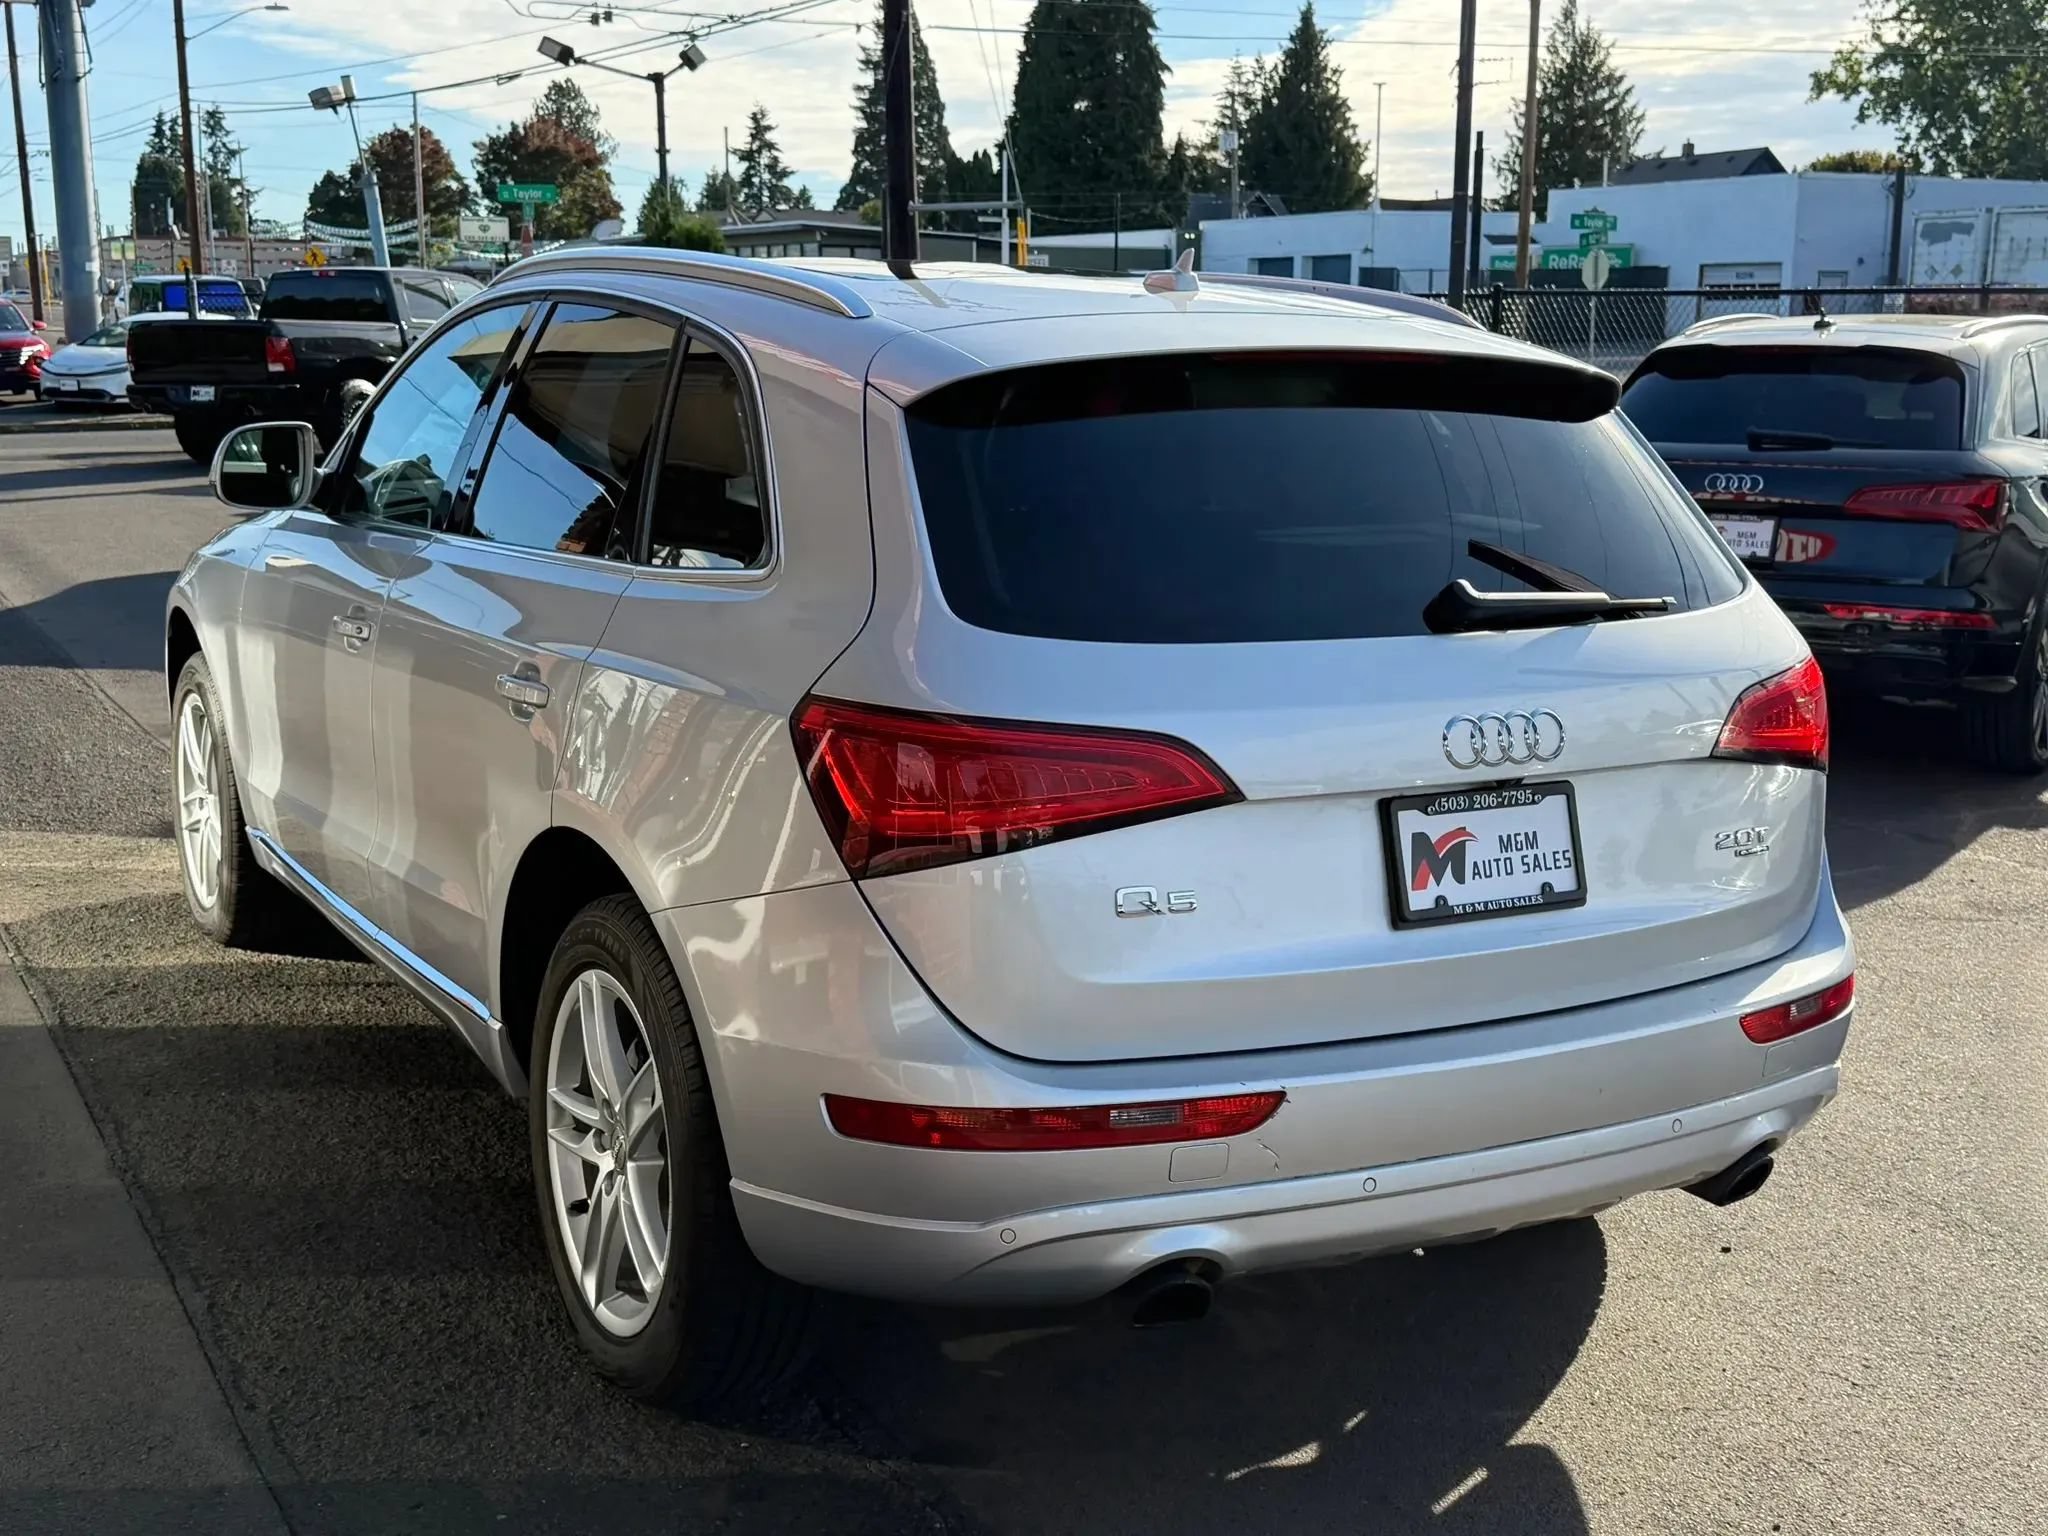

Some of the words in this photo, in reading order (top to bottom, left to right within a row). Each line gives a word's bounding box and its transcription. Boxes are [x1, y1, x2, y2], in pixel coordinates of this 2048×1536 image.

[512, 188, 542, 200] Taylor
[1745, 541, 1769, 549] SALES
[1434, 796, 1469, 812] (503)
[1473, 789, 1533, 808] 206-7795
[1498, 831, 1539, 854] M&M
[1472, 857, 1514, 880] AUTO
[1521, 849, 1572, 874] SALES
[1115, 885, 1197, 918] Q5
[1453, 905, 1464, 915] M
[1475, 902, 1485, 912] M
[1487, 899, 1513, 910] AUTO
[1514, 895, 1544, 907] SALES
